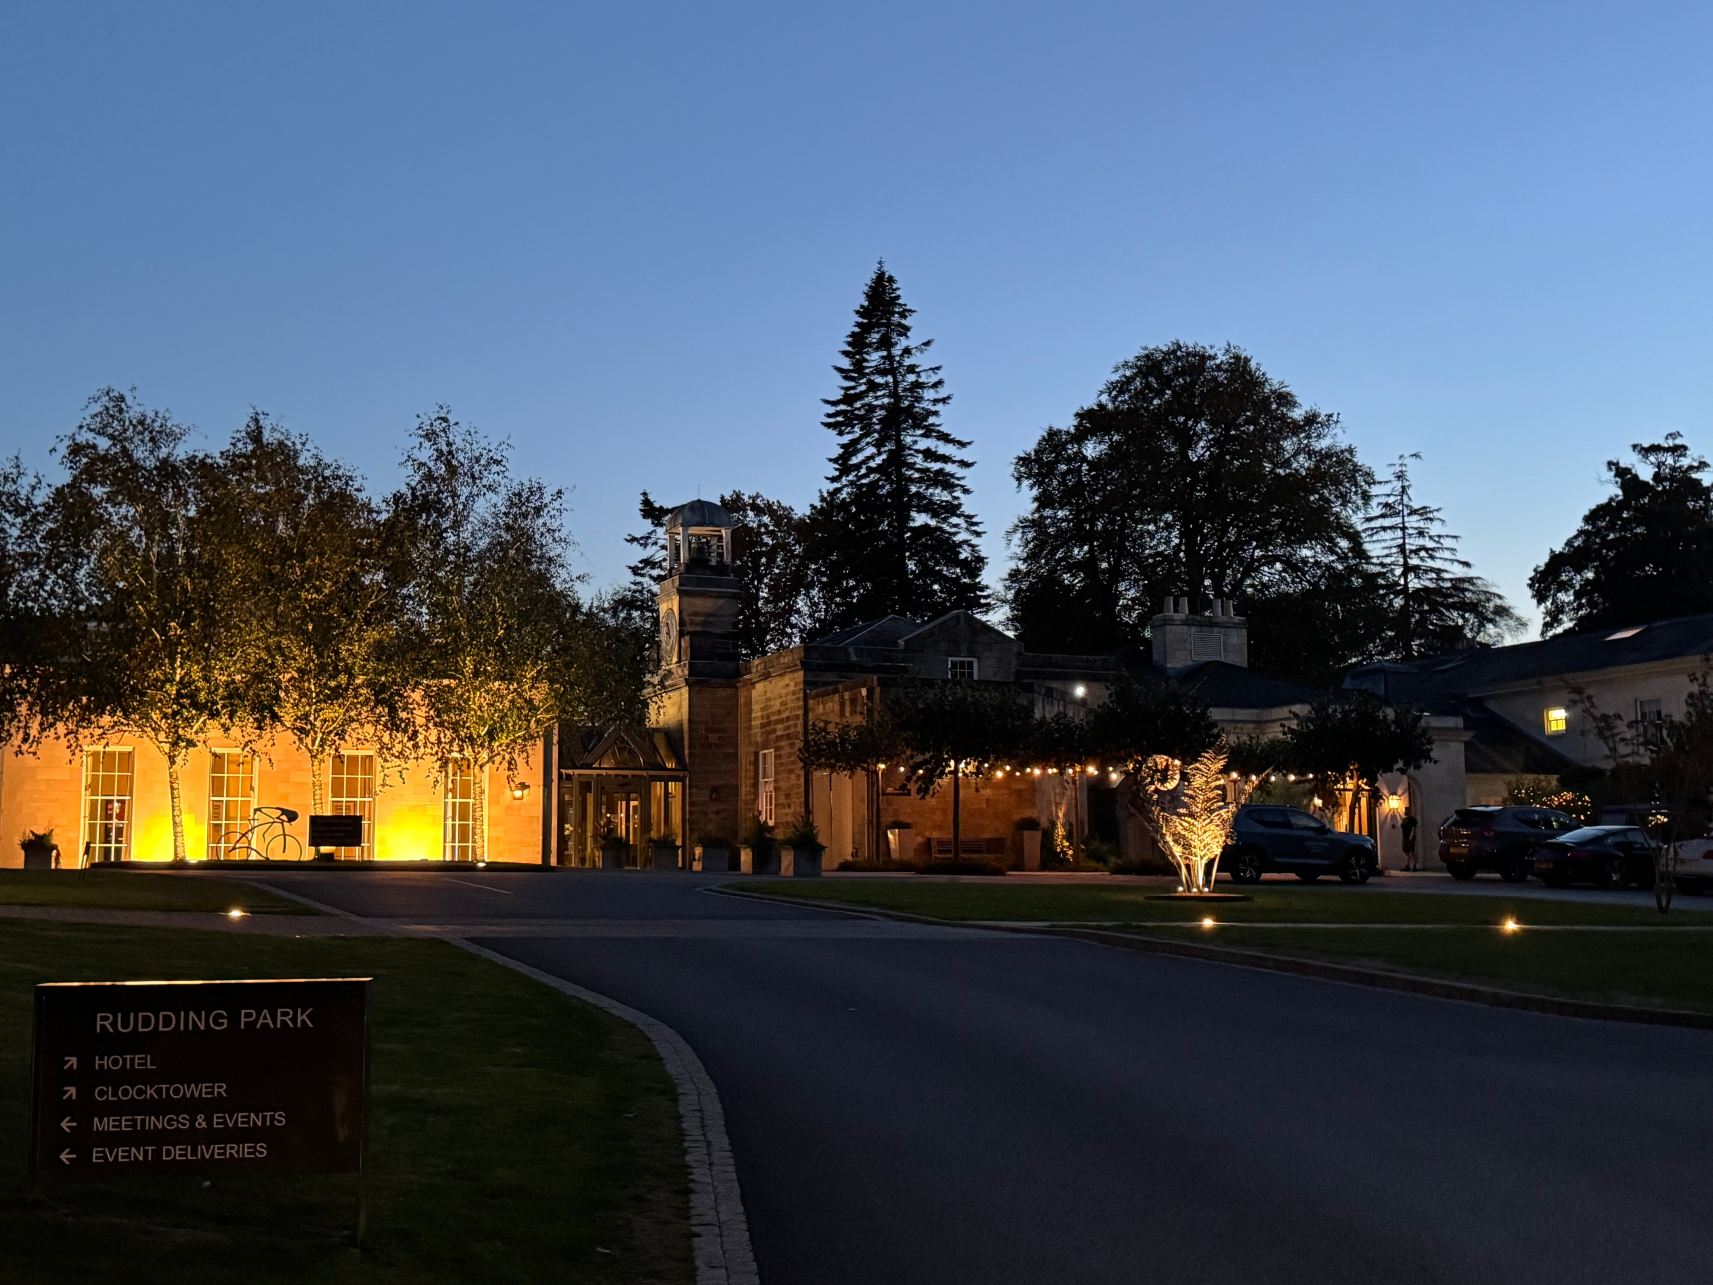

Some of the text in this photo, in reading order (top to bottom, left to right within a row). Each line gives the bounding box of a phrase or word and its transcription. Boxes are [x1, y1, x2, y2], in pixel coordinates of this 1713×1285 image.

[96, 1008, 314, 1034] RUDDING PARK
[95, 1054, 156, 1071] HOTEL
[95, 1083, 228, 1101] CLOCKTOWER
[93, 1112, 286, 1132] MEETINGS & EVENTS
[92, 1143, 267, 1162] EVENT DELIVERIES
